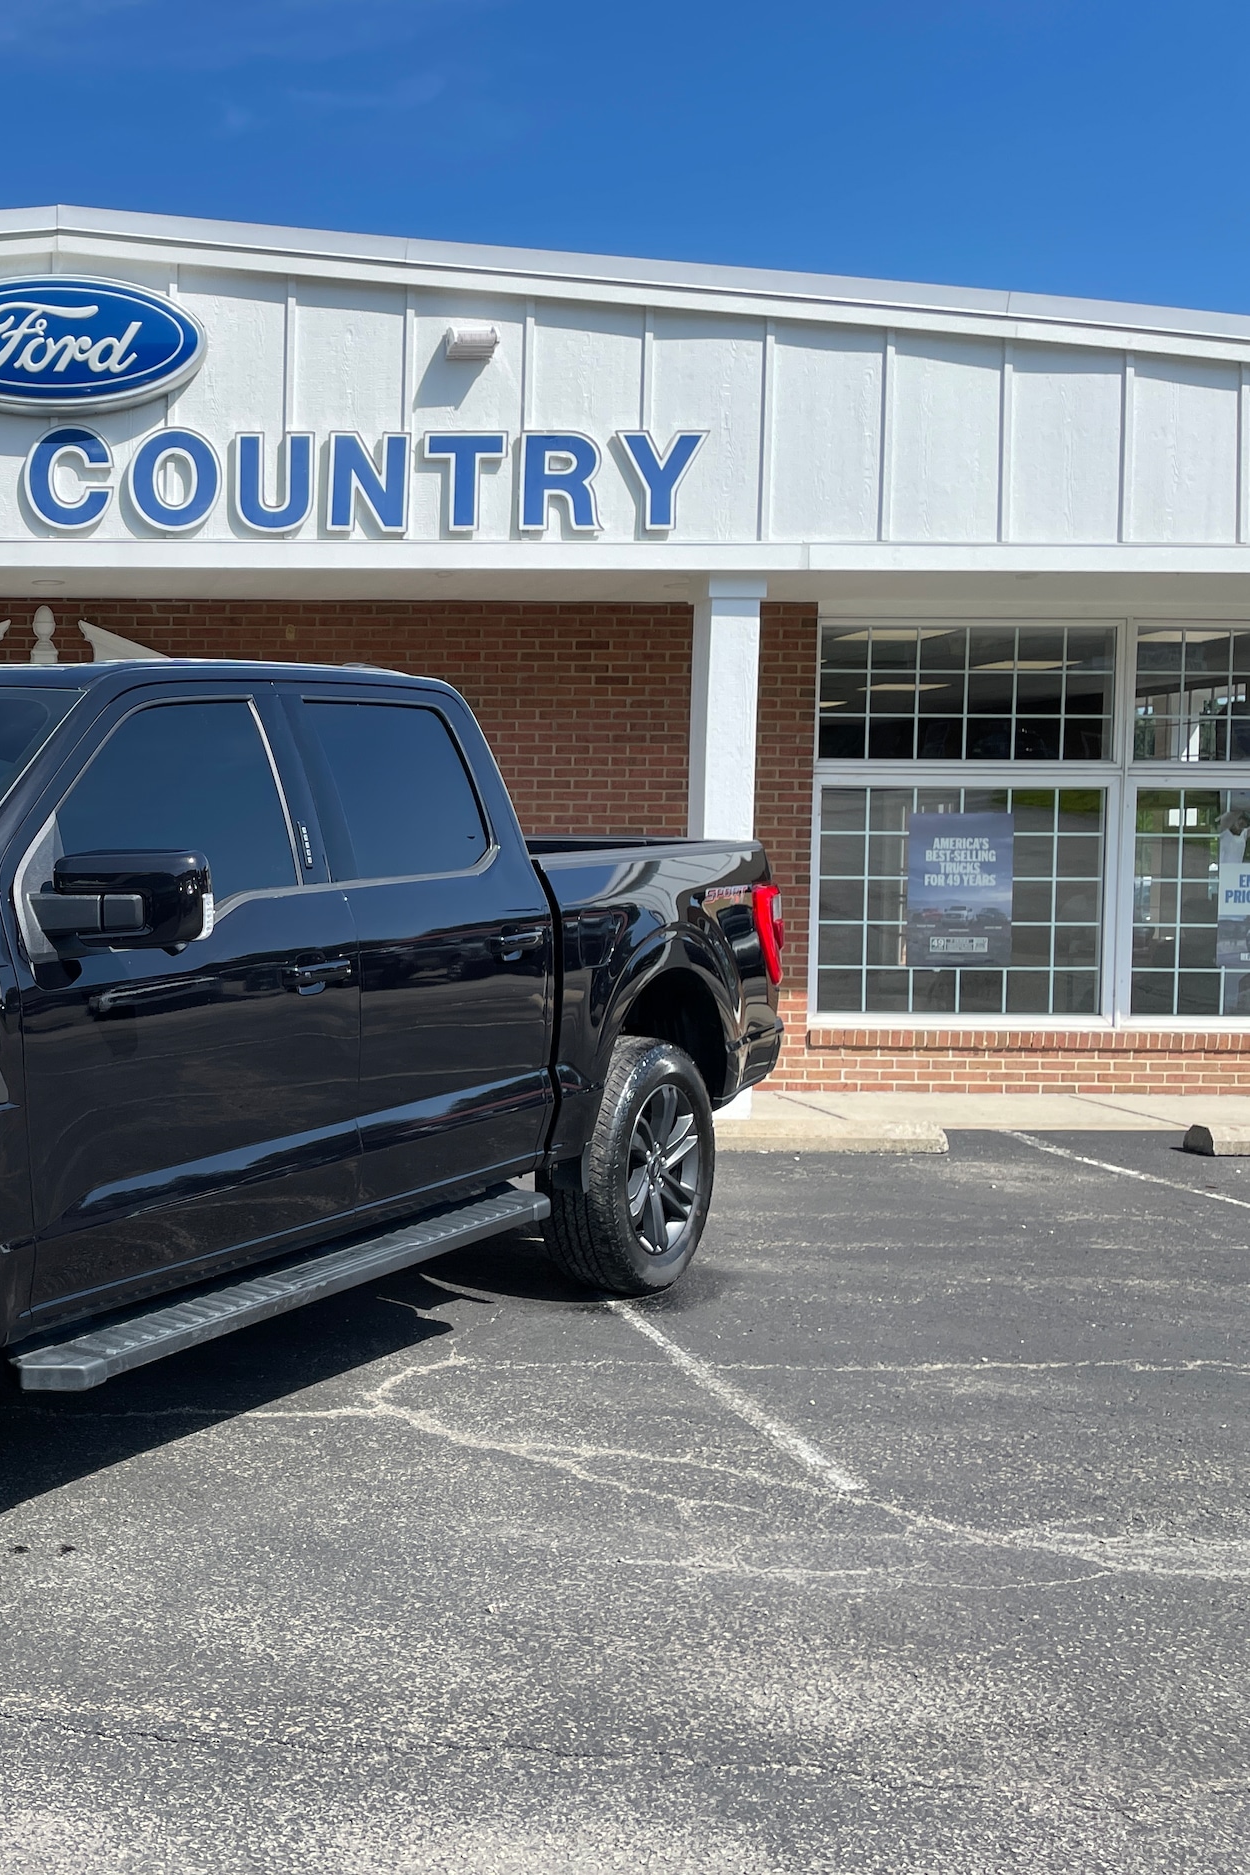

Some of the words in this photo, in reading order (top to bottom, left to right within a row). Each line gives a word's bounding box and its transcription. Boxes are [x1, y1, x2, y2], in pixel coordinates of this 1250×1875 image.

[24, 424, 710, 533] COUNTRY
[932, 837, 990, 850] AMERICA'S
[925, 849, 997, 862] BEST-SELLING
[939, 862, 981, 874] TRUCKS
[924, 873, 945, 886] FOR
[946, 874, 960, 886] 49
[962, 874, 996, 887] YEARS
